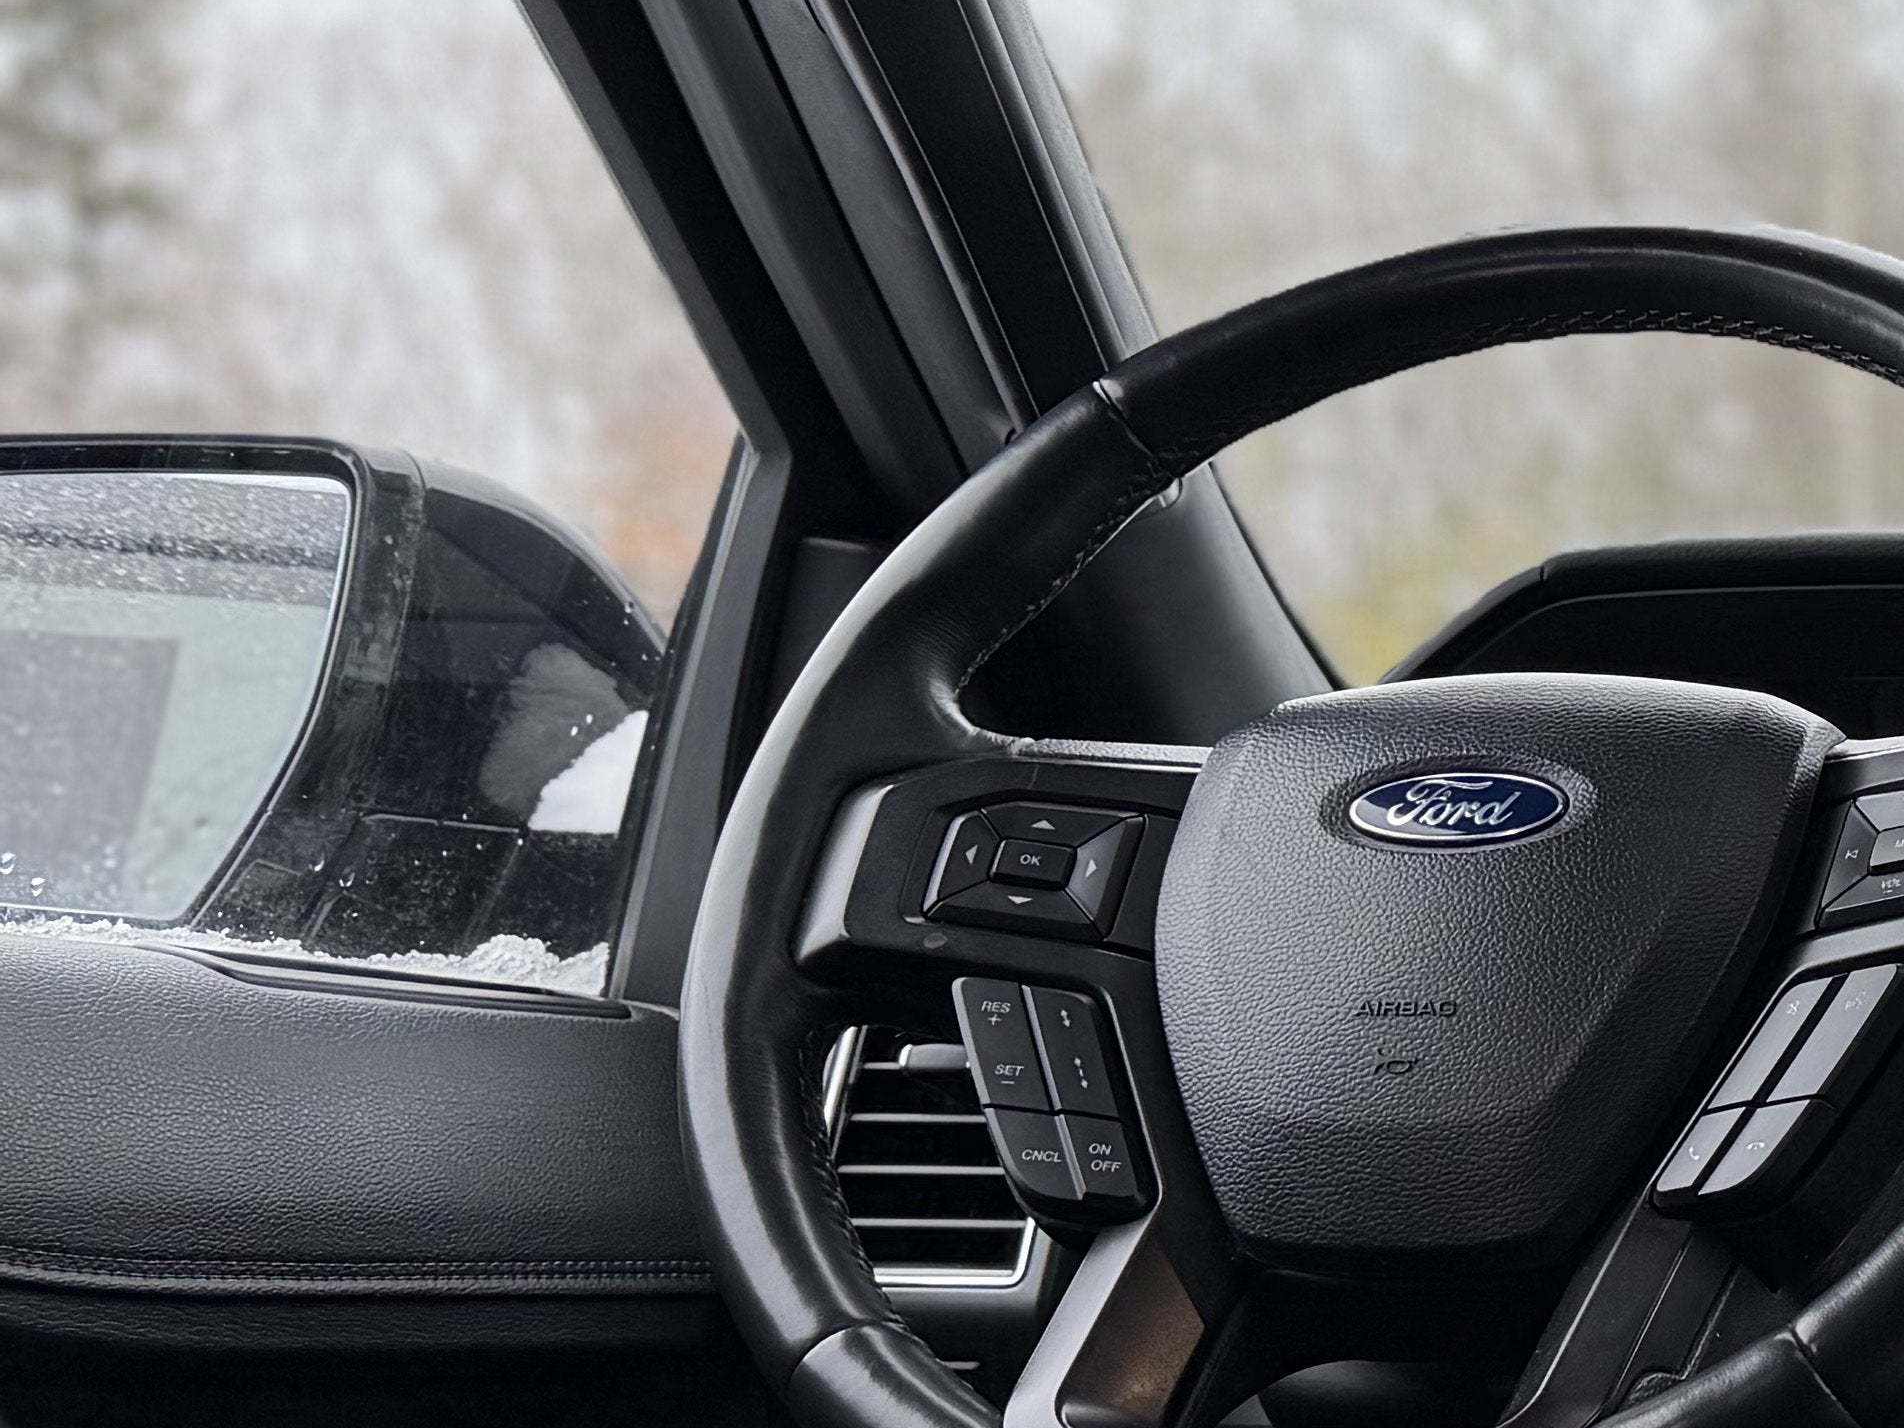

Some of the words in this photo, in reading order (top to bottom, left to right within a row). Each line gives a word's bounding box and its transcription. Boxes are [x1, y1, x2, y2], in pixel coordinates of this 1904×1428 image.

[1386, 779, 1514, 827] Ford
[1020, 853, 1041, 867] OK
[981, 1000, 1010, 1014] RES
[1355, 999, 1458, 1018] AIRBAG
[994, 1064, 1024, 1077] SET
[1021, 1148, 1062, 1164] CNCL
[1088, 1143, 1112, 1156] ON
[1090, 1159, 1121, 1173] OFF
